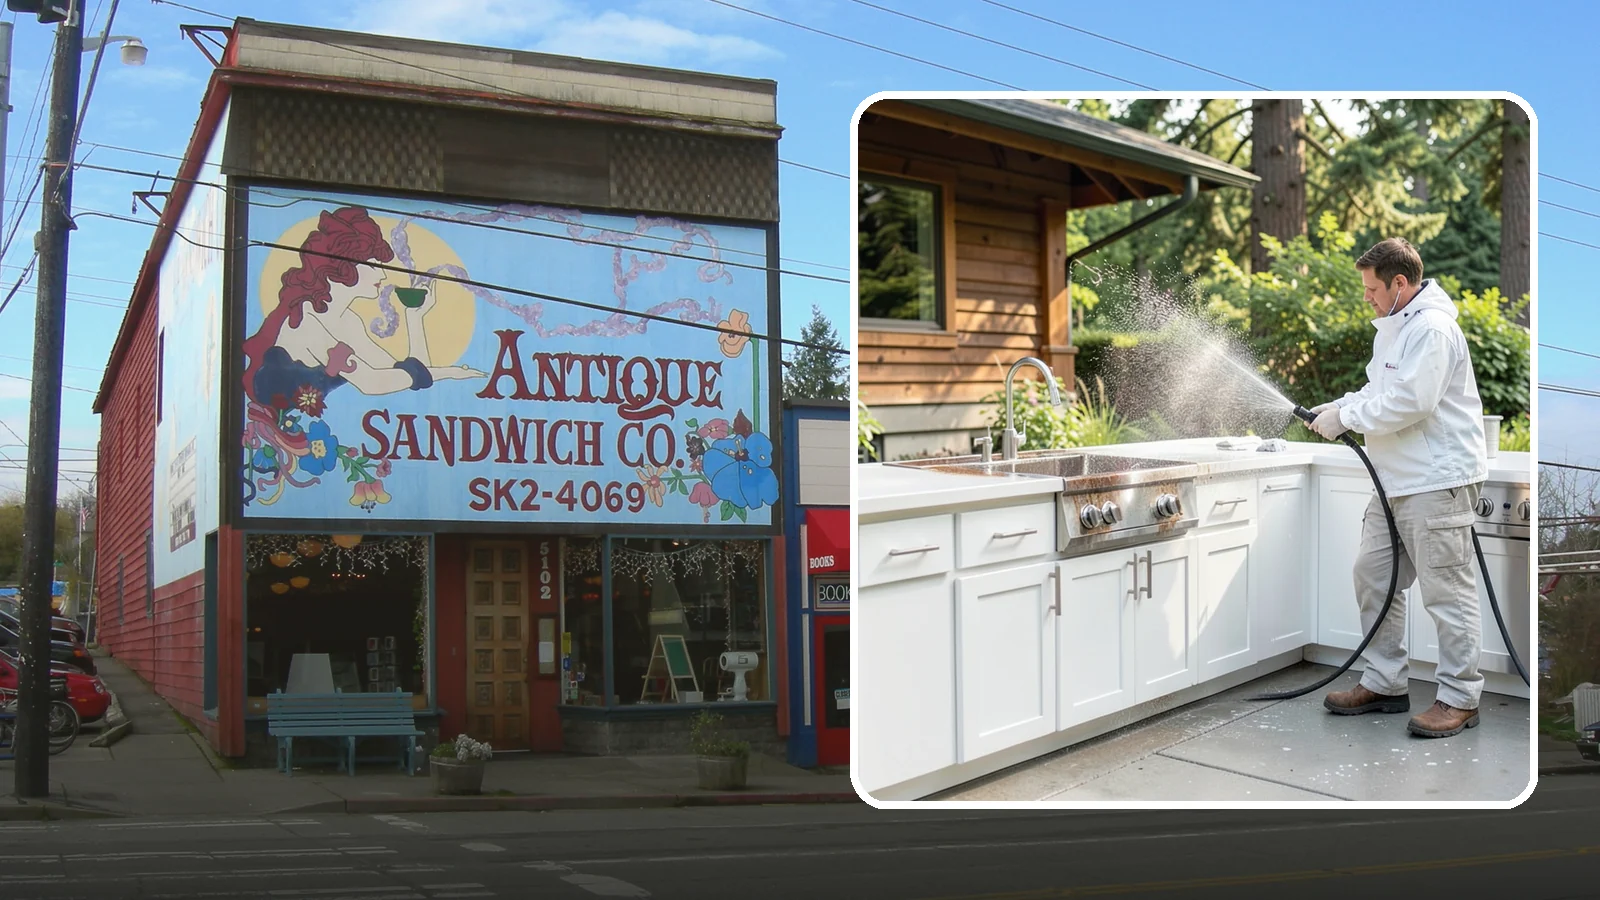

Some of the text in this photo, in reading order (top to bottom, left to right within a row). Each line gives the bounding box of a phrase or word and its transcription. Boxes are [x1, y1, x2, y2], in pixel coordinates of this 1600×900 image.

[476, 329, 724, 420] ANTIQUE
[361, 408, 685, 468] SANDWICH CO.
[469, 477, 645, 513] SK2-4069
[540, 542, 552, 600] 5102
[809, 555, 835, 569] BOOKS
